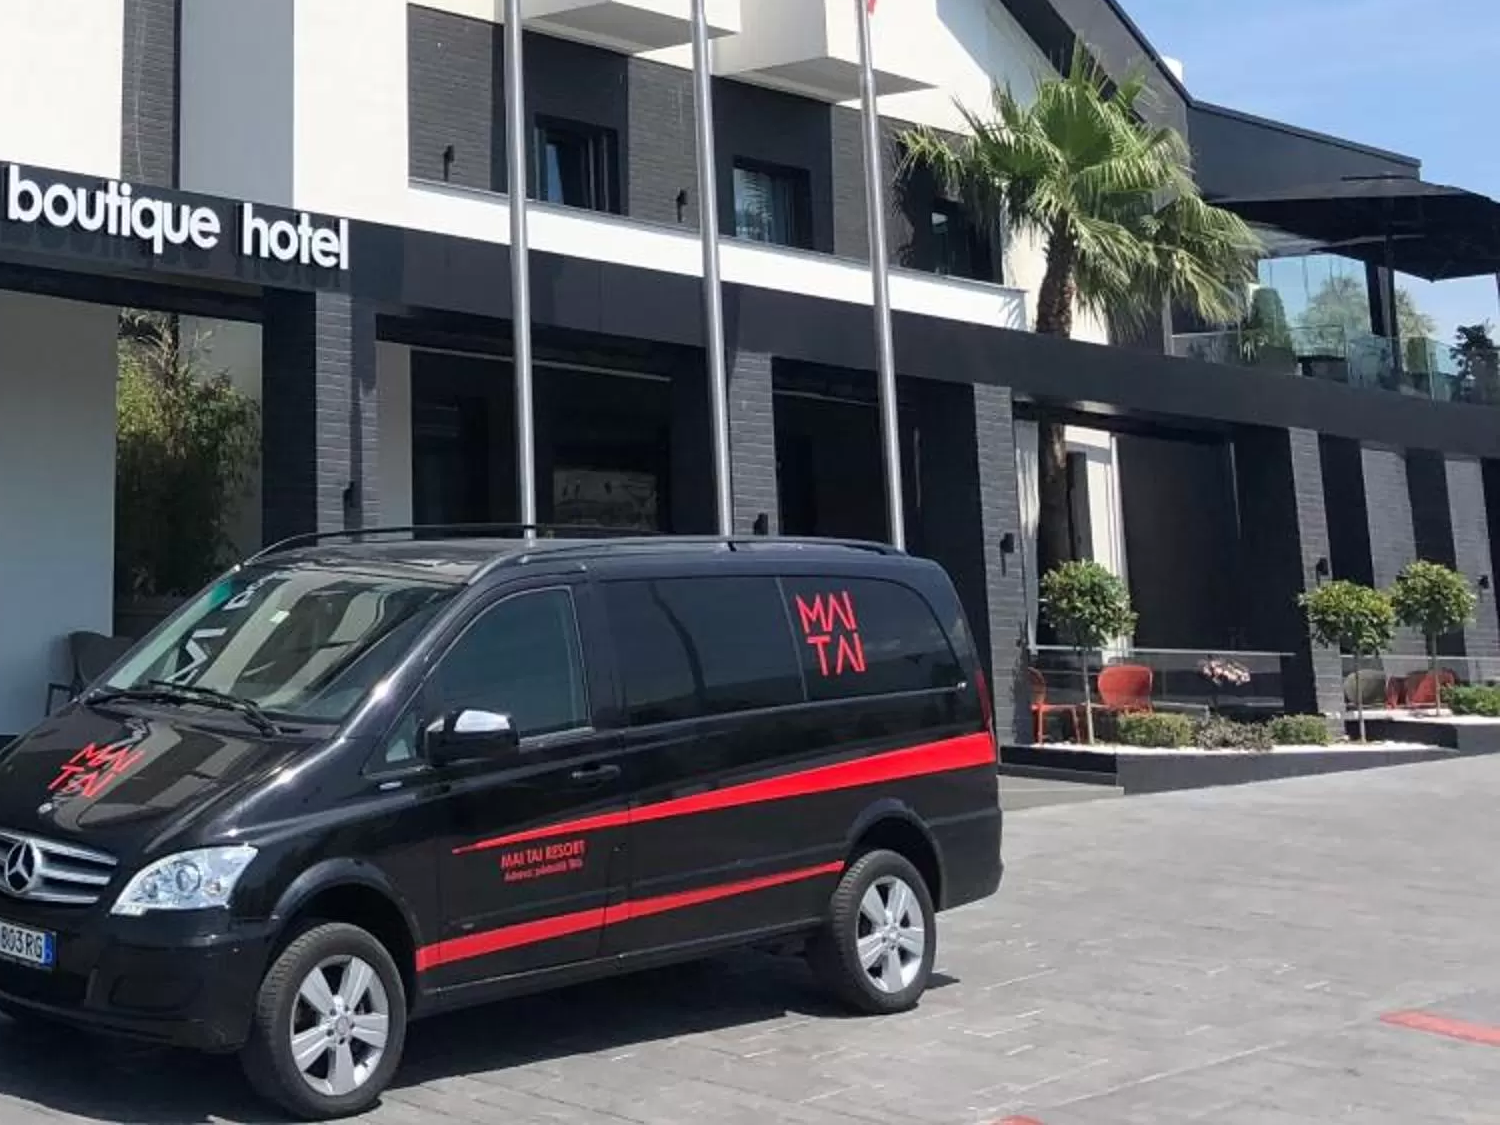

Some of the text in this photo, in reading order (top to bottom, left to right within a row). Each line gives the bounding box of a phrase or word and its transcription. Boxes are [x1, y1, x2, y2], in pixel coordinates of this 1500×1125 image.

[8, 163, 221, 255] boutique
[242, 201, 349, 271] hotel
[795, 590, 857, 633] MAI
[806, 632, 866, 676] TAI
[501, 851, 524, 869] MAI
